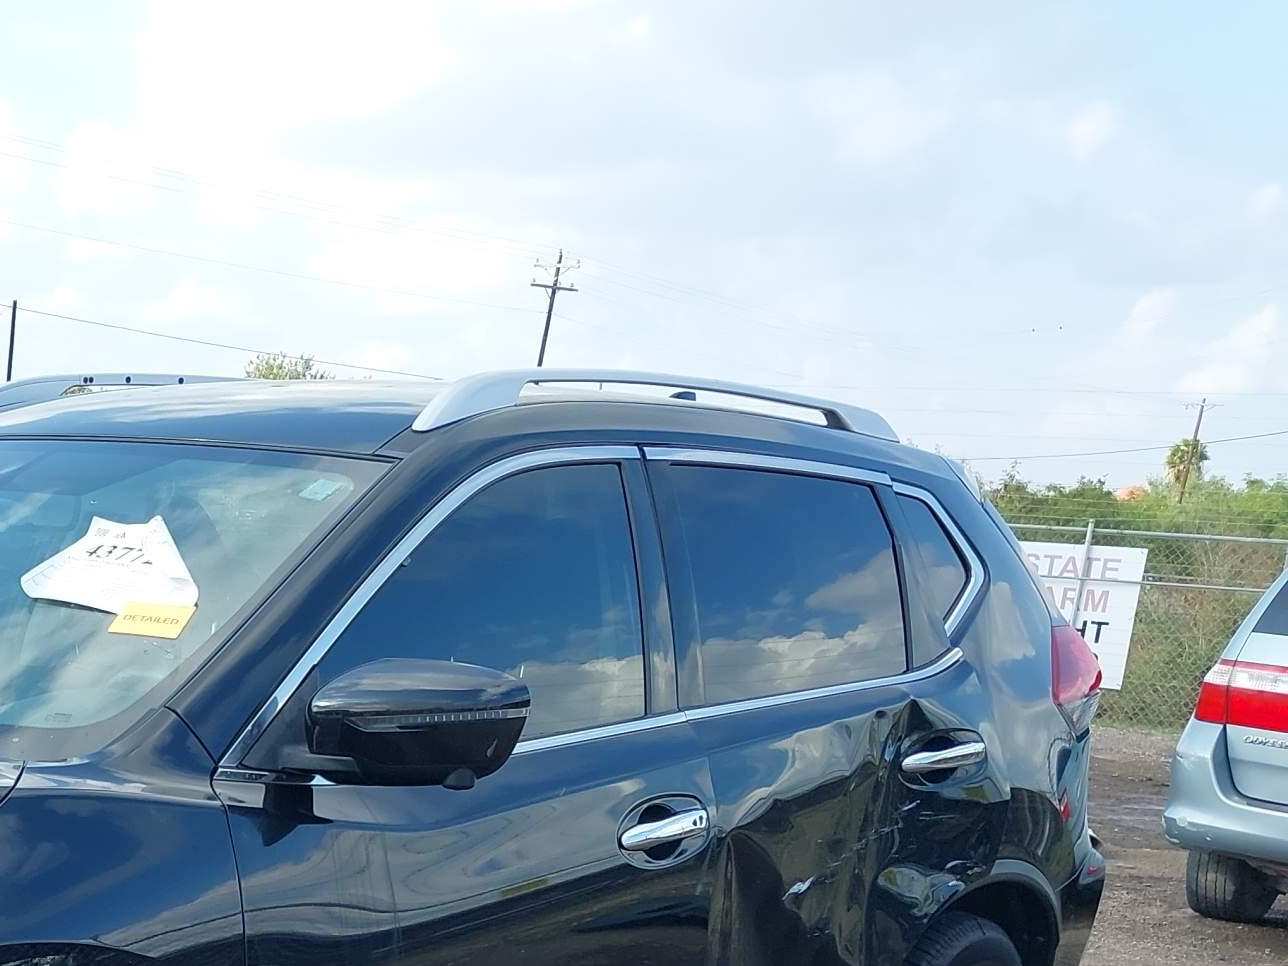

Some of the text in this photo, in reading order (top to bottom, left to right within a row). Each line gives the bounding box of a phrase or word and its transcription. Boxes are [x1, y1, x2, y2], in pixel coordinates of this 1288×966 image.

[86, 544, 152, 565] 4377
[123, 614, 180, 625] DETAILED
[1243, 735, 1288, 749] ODYSS
